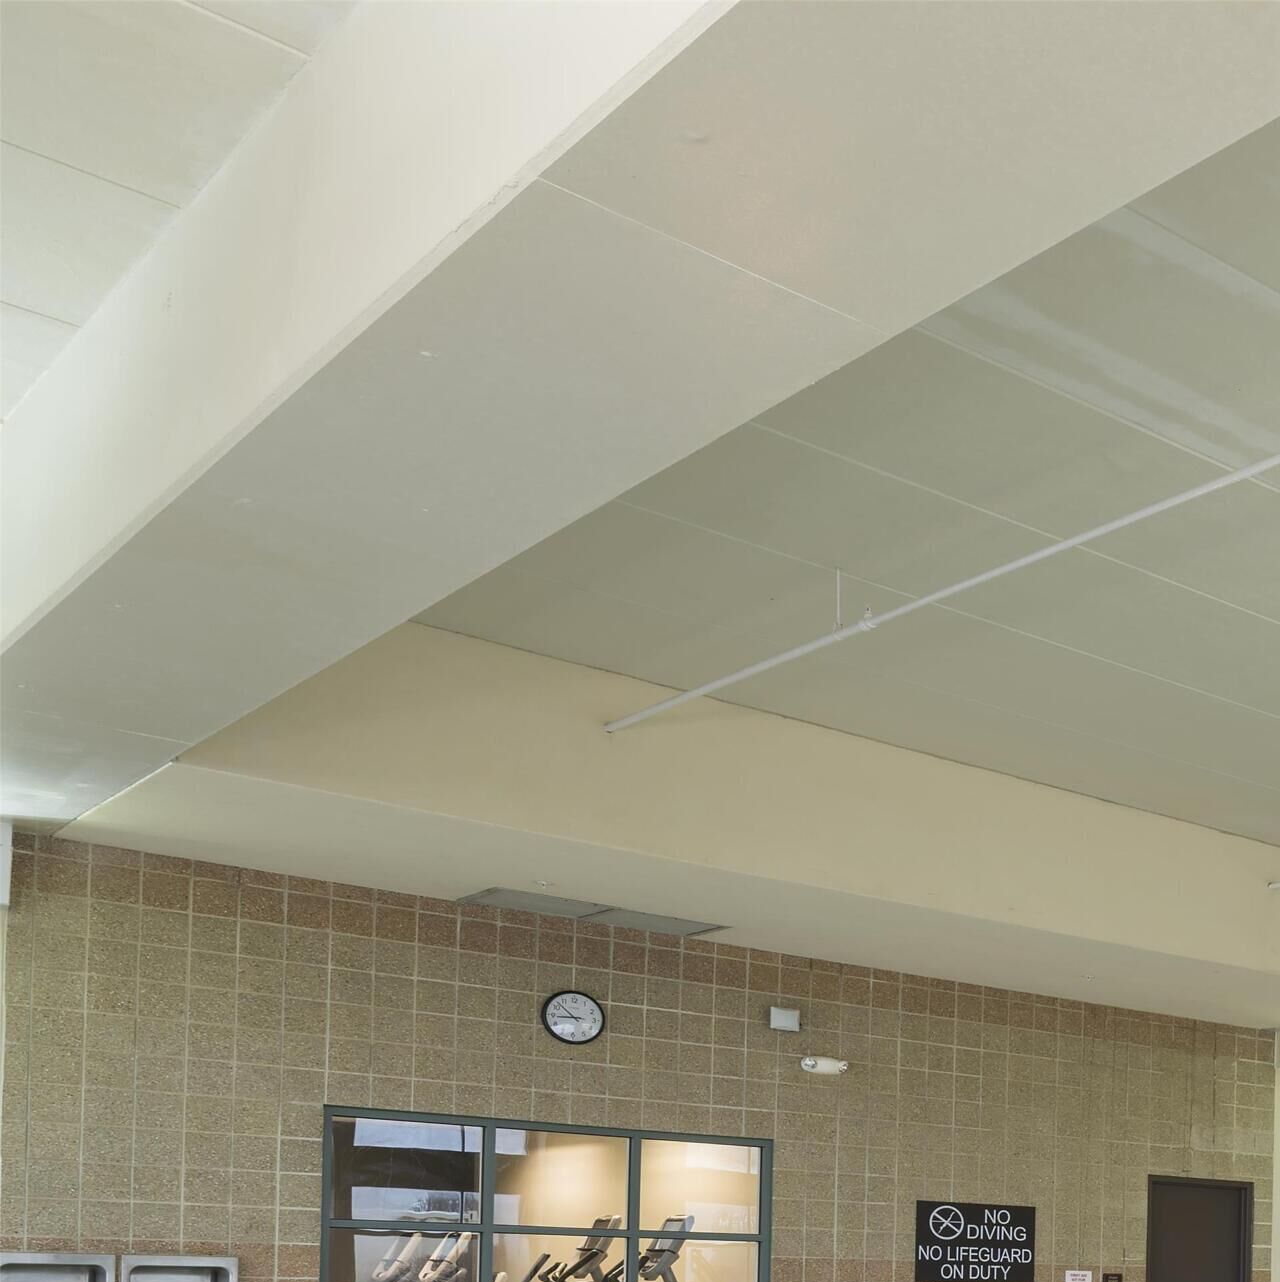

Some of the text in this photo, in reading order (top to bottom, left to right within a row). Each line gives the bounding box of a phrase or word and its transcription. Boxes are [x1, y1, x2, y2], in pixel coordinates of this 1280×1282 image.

[984, 1209, 1011, 1225] NO
[966, 1225, 1027, 1241] DIVING
[918, 1245, 1032, 1263] NO LIFEGUARD
[940, 1264, 1011, 1281] ON DUTY
